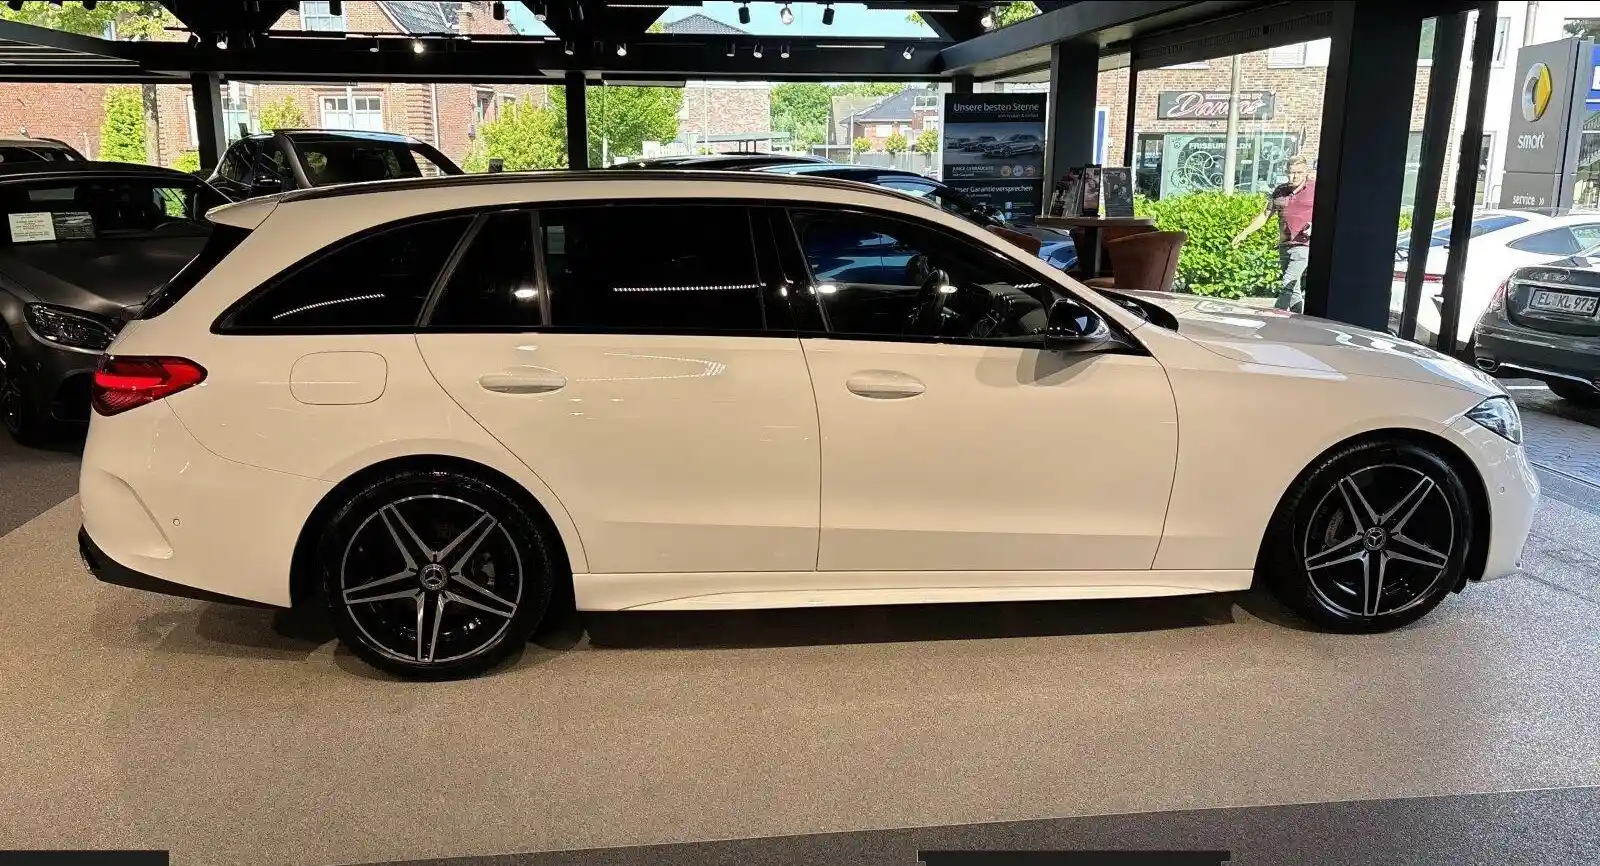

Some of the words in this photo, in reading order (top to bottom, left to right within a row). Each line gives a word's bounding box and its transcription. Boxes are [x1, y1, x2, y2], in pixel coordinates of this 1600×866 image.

[953, 103, 982, 112] Unsere
[983, 102, 1012, 111] besten
[1013, 102, 1039, 111] Sterne
[1517, 131, 1545, 149] smart
[953, 185, 969, 193] nser
[970, 185, 1033, 193] Garantieversprechen
[1512, 192, 1536, 206] service
[1537, 292, 1551, 306] EL
[1556, 294, 1572, 309] KL
[1573, 296, 1597, 312] 973
